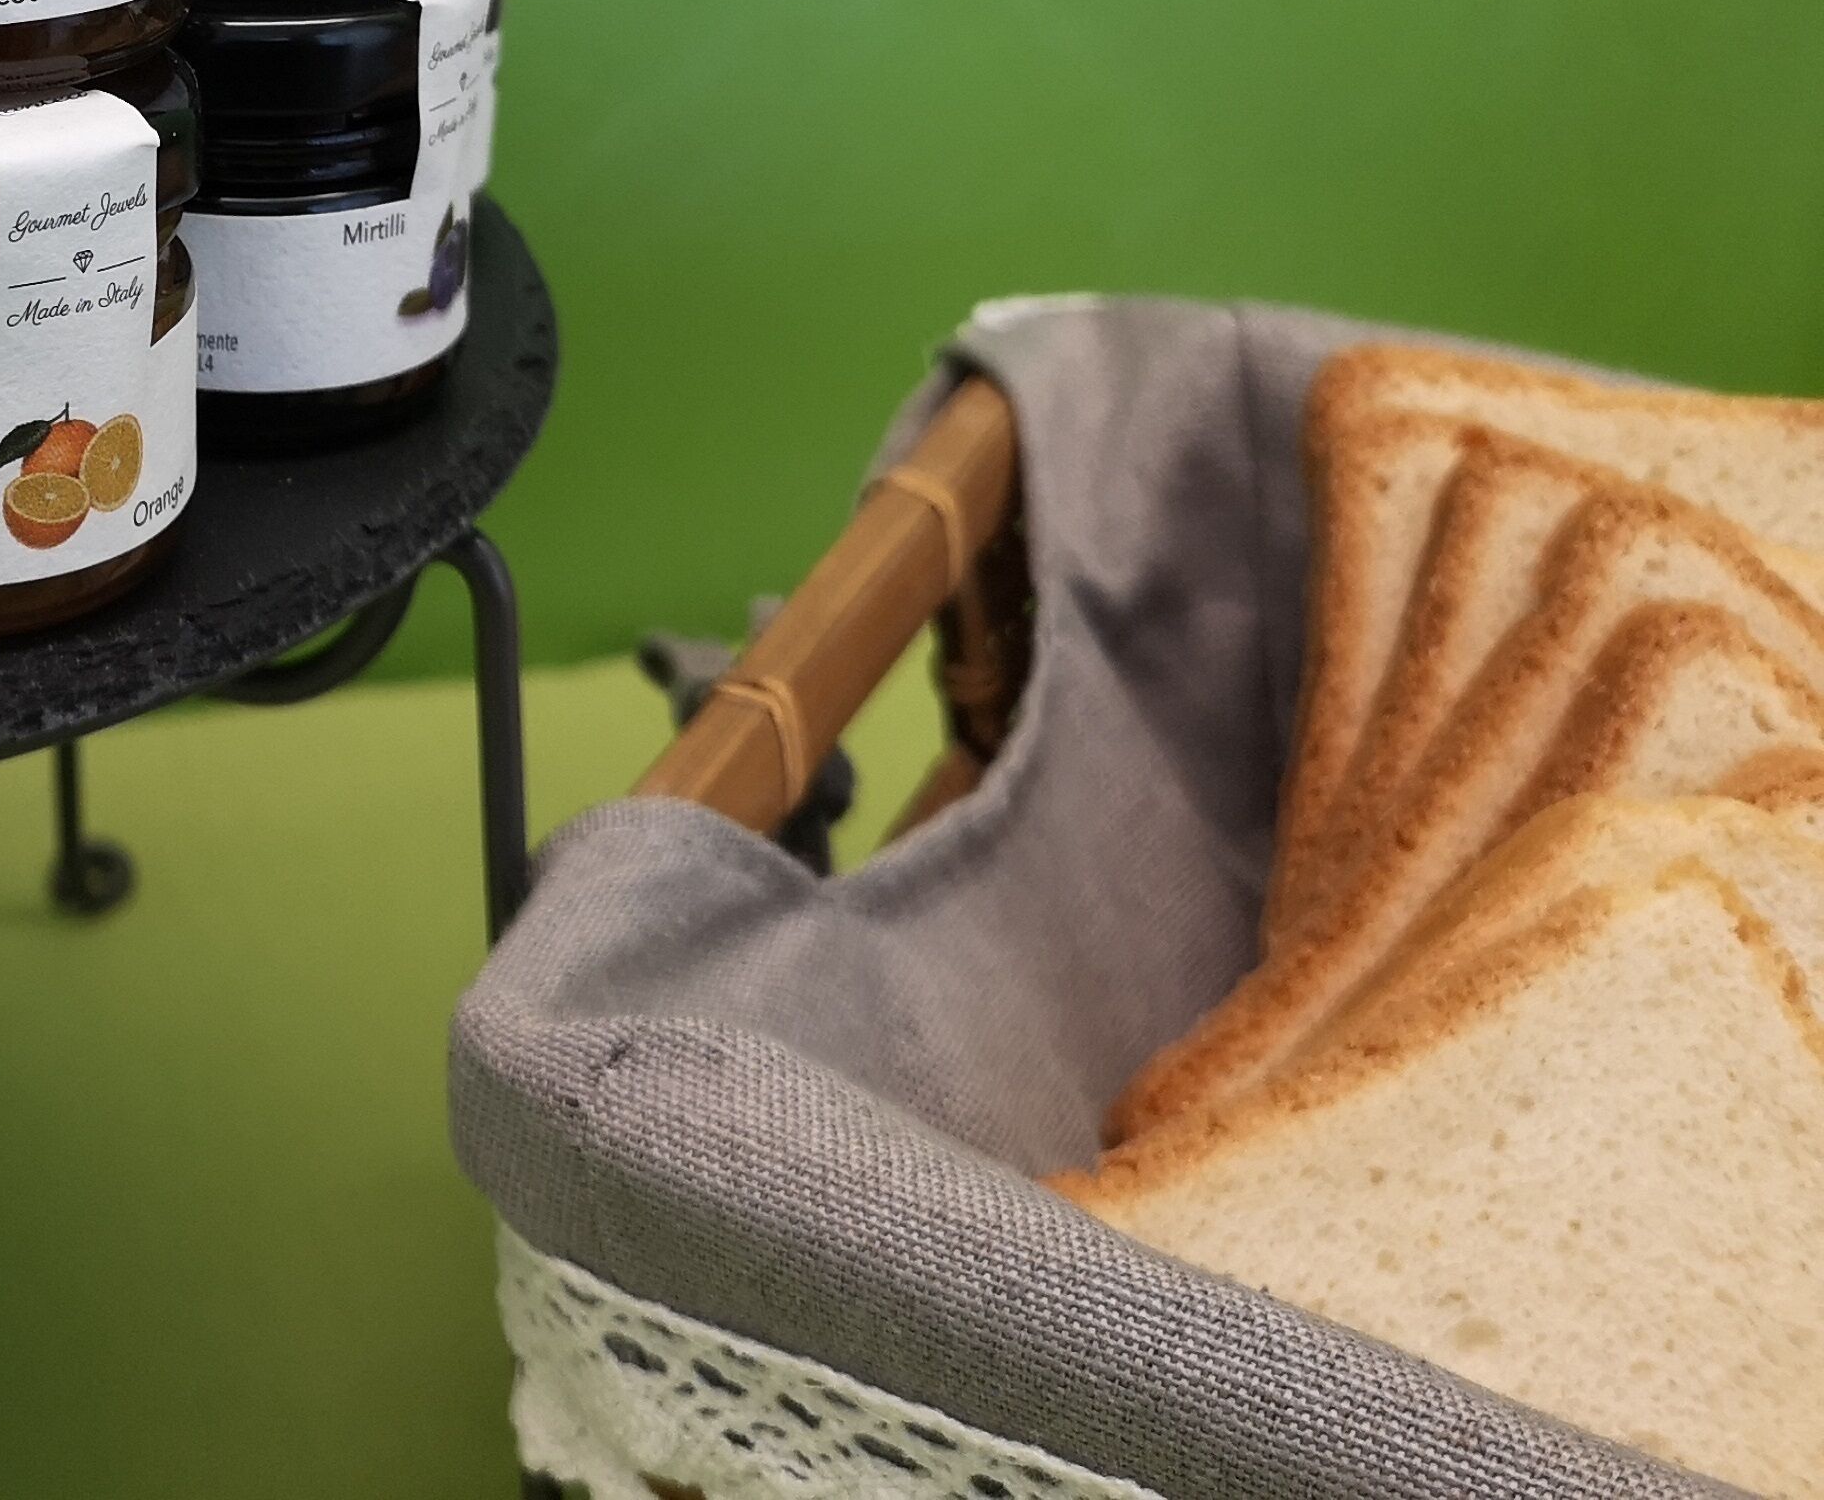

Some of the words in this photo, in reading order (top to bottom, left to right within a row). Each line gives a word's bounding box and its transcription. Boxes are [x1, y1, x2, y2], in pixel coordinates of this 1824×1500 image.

[8, 204, 89, 243] Gourmet
[91, 183, 148, 231] Jewels
[343, 213, 405, 247] Mirtilli
[6, 299, 70, 328] Made
[75, 298, 93, 314] in
[97, 275, 143, 311] Italy
[197, 333, 238, 352] mente
[132, 474, 185, 529] Orange
